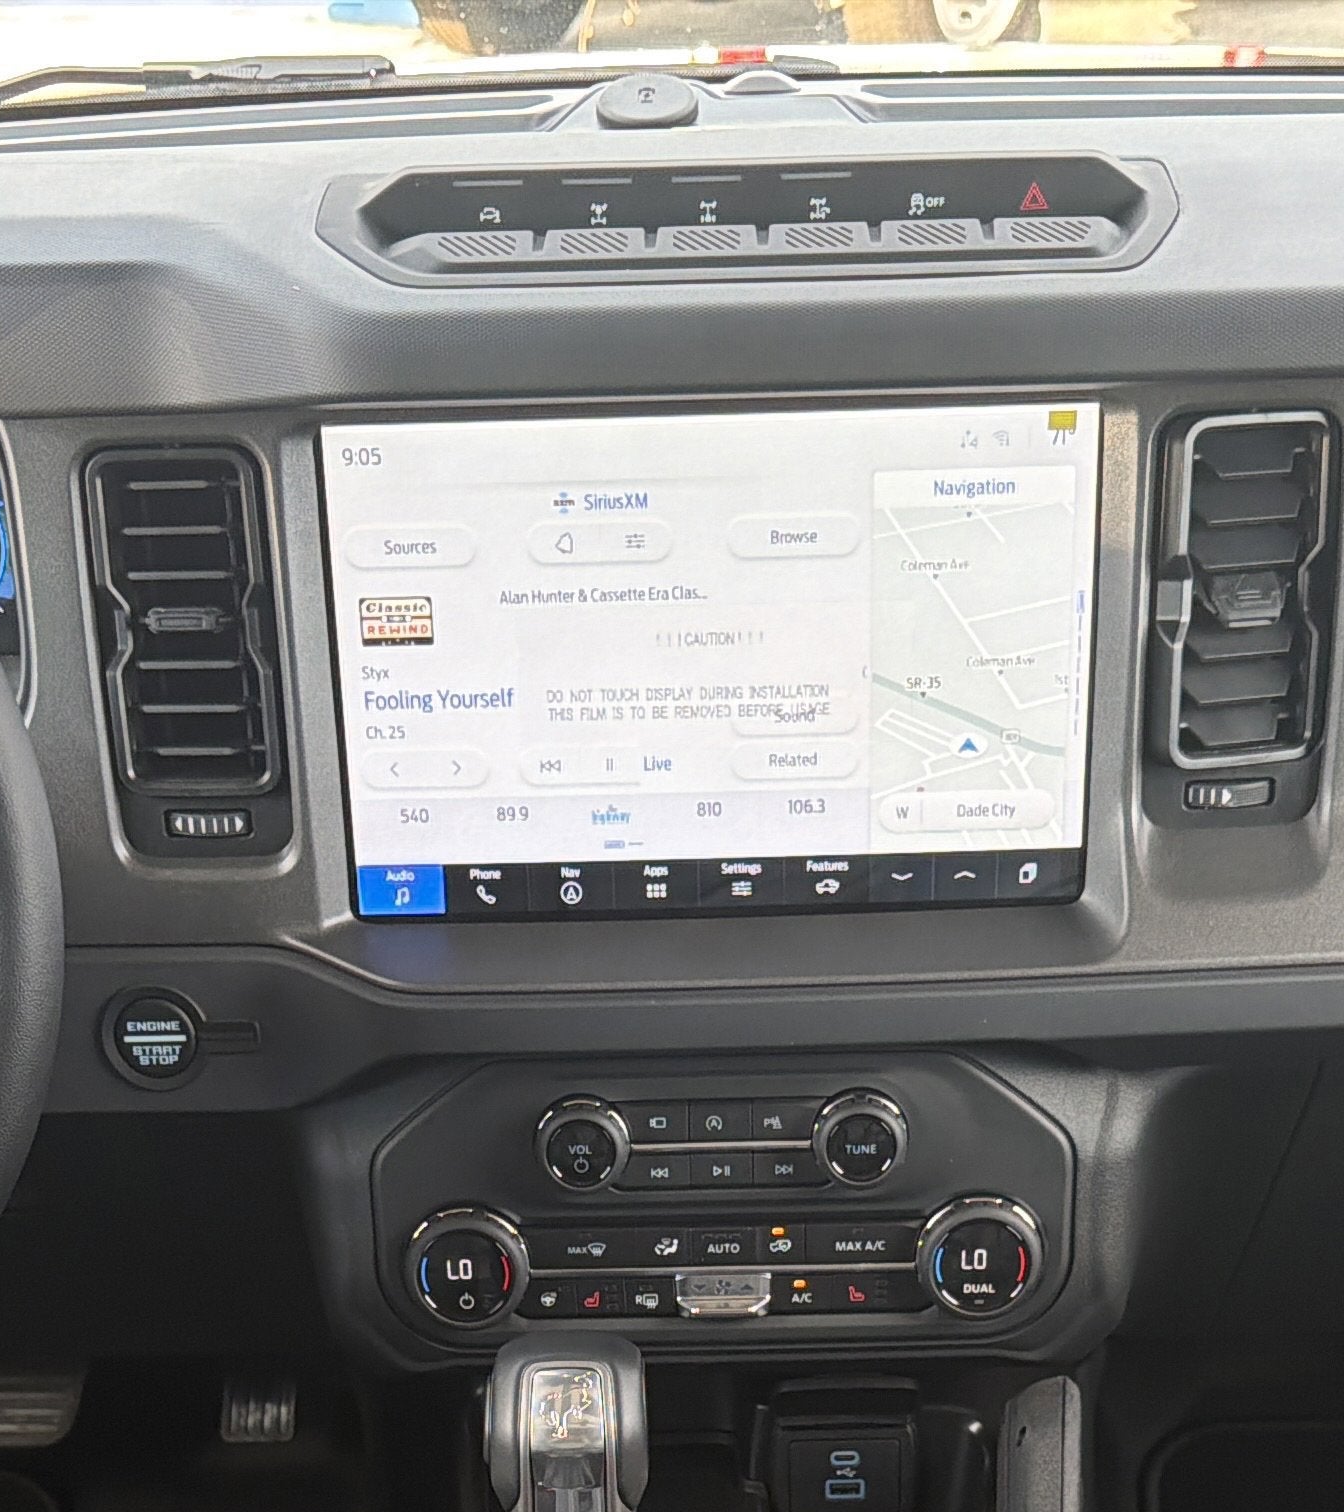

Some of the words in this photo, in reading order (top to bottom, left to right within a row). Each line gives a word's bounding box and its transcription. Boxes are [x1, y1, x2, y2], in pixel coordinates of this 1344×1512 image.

[925, 196, 945, 208] OFF
[342, 447, 382, 467] 9:05
[933, 478, 1016, 499] Navigation
[584, 493, 648, 512] SiriusXM
[770, 530, 818, 545] Browse
[384, 540, 437, 556] Sources
[499, 590, 529, 605] Alan
[531, 588, 575, 604] Hunter
[590, 586, 646, 602] Cassette
[648, 586, 669, 601] Era
[367, 623, 429, 636] REWIND
[685, 631, 735, 647] CAUTION
[362, 665, 390, 682] Styx
[364, 690, 434, 713] Fooling
[437, 687, 514, 709] Yourself
[546, 690, 564, 703] DO
[599, 688, 639, 702] TOUCH
[646, 686, 693, 701] DISPLAY
[700, 685, 744, 700] DURING
[548, 707, 573, 721] THIS
[580, 706, 607, 721] FILM
[652, 705, 669, 719] BE
[674, 704, 732, 719] REMOVED
[643, 756, 672, 772] Live
[768, 753, 818, 768] Related
[696, 802, 722, 817] 810
[787, 799, 826, 814] 106.3
[896, 805, 909, 819] W
[957, 803, 990, 818] Dade
[992, 802, 1016, 819] City
[400, 808, 430, 824] 540
[560, 866, 581, 879] Nav
[644, 864, 669, 879] Apps
[720, 862, 762, 875] Settings
[806, 860, 849, 873] Features
[385, 869, 415, 882] Audio
[469, 868, 502, 881] Phone
[126, 1021, 181, 1032] ENGINE
[132, 1045, 182, 1056] START
[139, 1055, 179, 1066] STOP
[568, 1145, 592, 1155] VOL
[845, 1144, 877, 1155] TUNE
[567, 1246, 588, 1255] MAX
[707, 1243, 740, 1254] AUTO
[835, 1241, 862, 1252] MAX
[864, 1240, 886, 1251] A/C
[963, 1283, 996, 1294] DUAL
[791, 1292, 813, 1304] A/C
